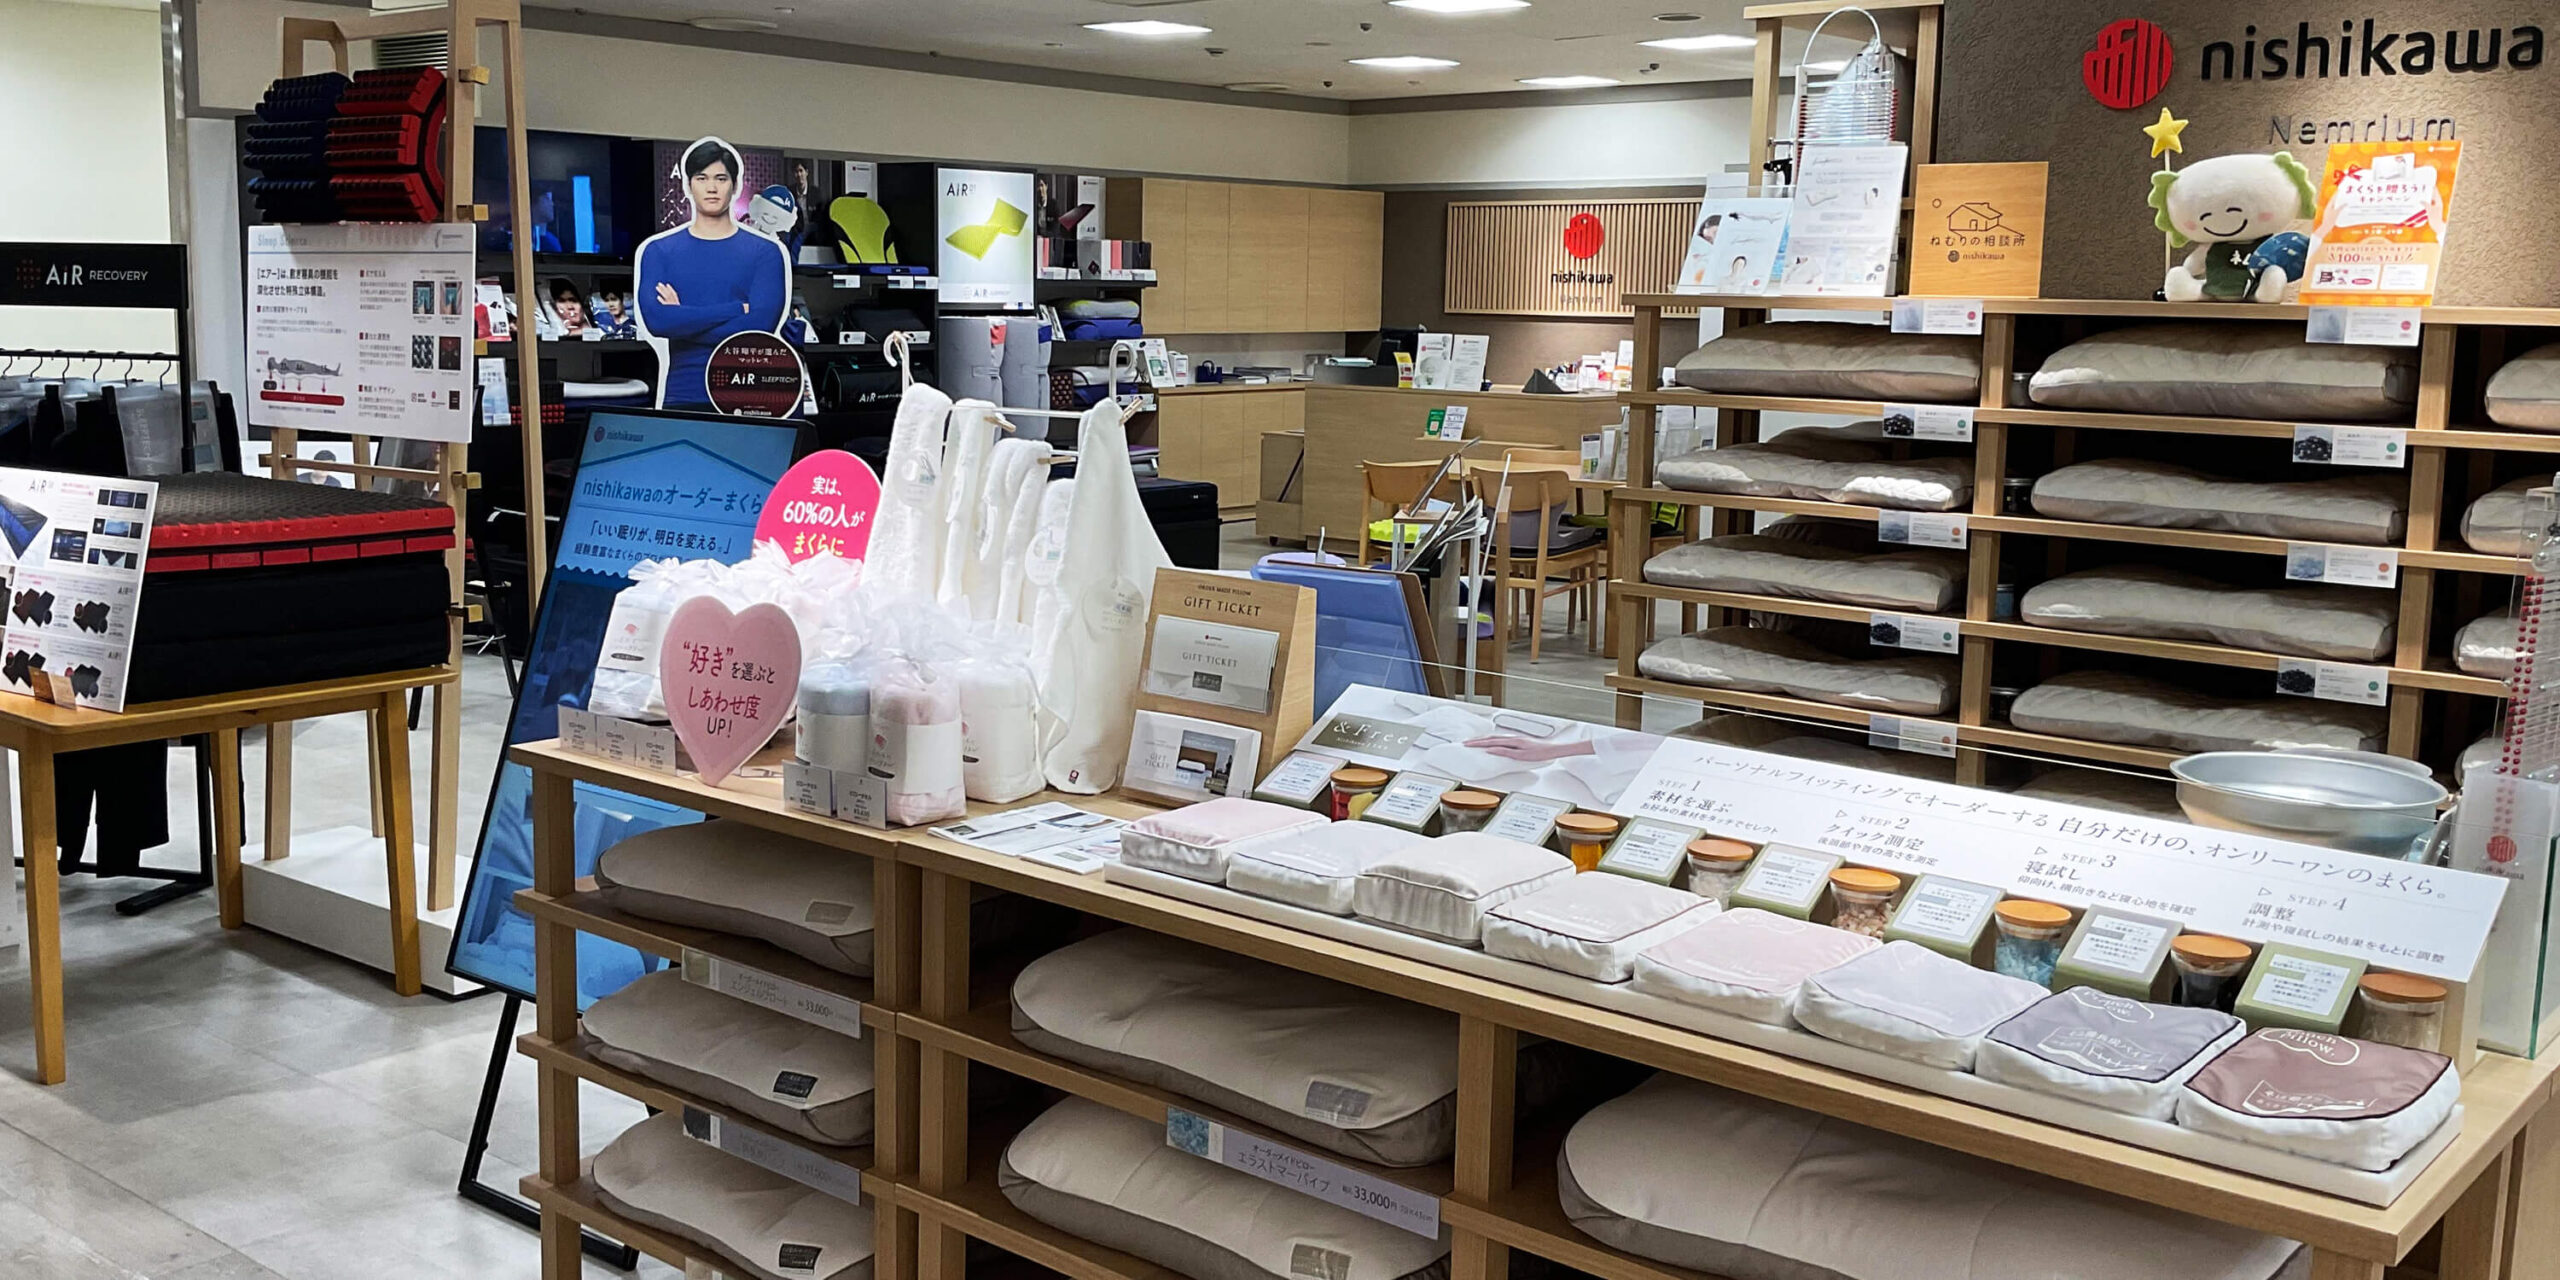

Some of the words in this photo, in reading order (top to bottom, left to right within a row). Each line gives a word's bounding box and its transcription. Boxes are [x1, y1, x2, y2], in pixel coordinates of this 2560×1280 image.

[2200, 17, 2545, 82] nishikawa
[2268, 112, 2457, 145] Nemrium
[1929, 234, 2025, 247] ねむりの相談所
[45, 263, 83, 286] AiR
[89, 269, 148, 281] RECOVERY
[1551, 270, 1614, 285] nishikawa
[724, 346, 788, 356] 大谷翔平が選んだ
[730, 372, 756, 385] AiR
[606, 430, 645, 443] nishikawa
[582, 478, 762, 516] nishikawaのオーダーまくら
[811, 475, 842, 497] 実は、
[783, 500, 866, 529] 60%の人が
[590, 518, 733, 555] 「いい眠りが、明日を変える。」
[793, 531, 845, 556] まくらに
[1183, 595, 1212, 611] GIFT
[1217, 600, 1262, 617] TICKET
[1182, 651, 1203, 662] GIFT
[1205, 654, 1239, 668] TICKET
[688, 685, 762, 721] しあわせ度
[706, 717, 733, 738] UP!
[1648, 790, 1734, 813] 素材を選ぶ
[1640, 802, 1778, 834] お好みの素材をタッチでセレクト
[1858, 815, 1893, 827] STEP
[1894, 816, 1911, 831] 2
[1825, 823, 1926, 851] クイック測定
[1817, 836, 1940, 867] 後頭部や首の高さを測定
[2061, 852, 2098, 865] STEP
[2100, 854, 2117, 869] 3
[2023, 860, 2082, 881] 寝試し
[2017, 874, 2198, 916] 仰向け、横向きなど寝心地を確認
[2287, 893, 2328, 907] STEP
[2332, 896, 2348, 911] 4
[2248, 901, 2297, 922] 調整
[1238, 1150, 1331, 1193] エラストマーパイプ
